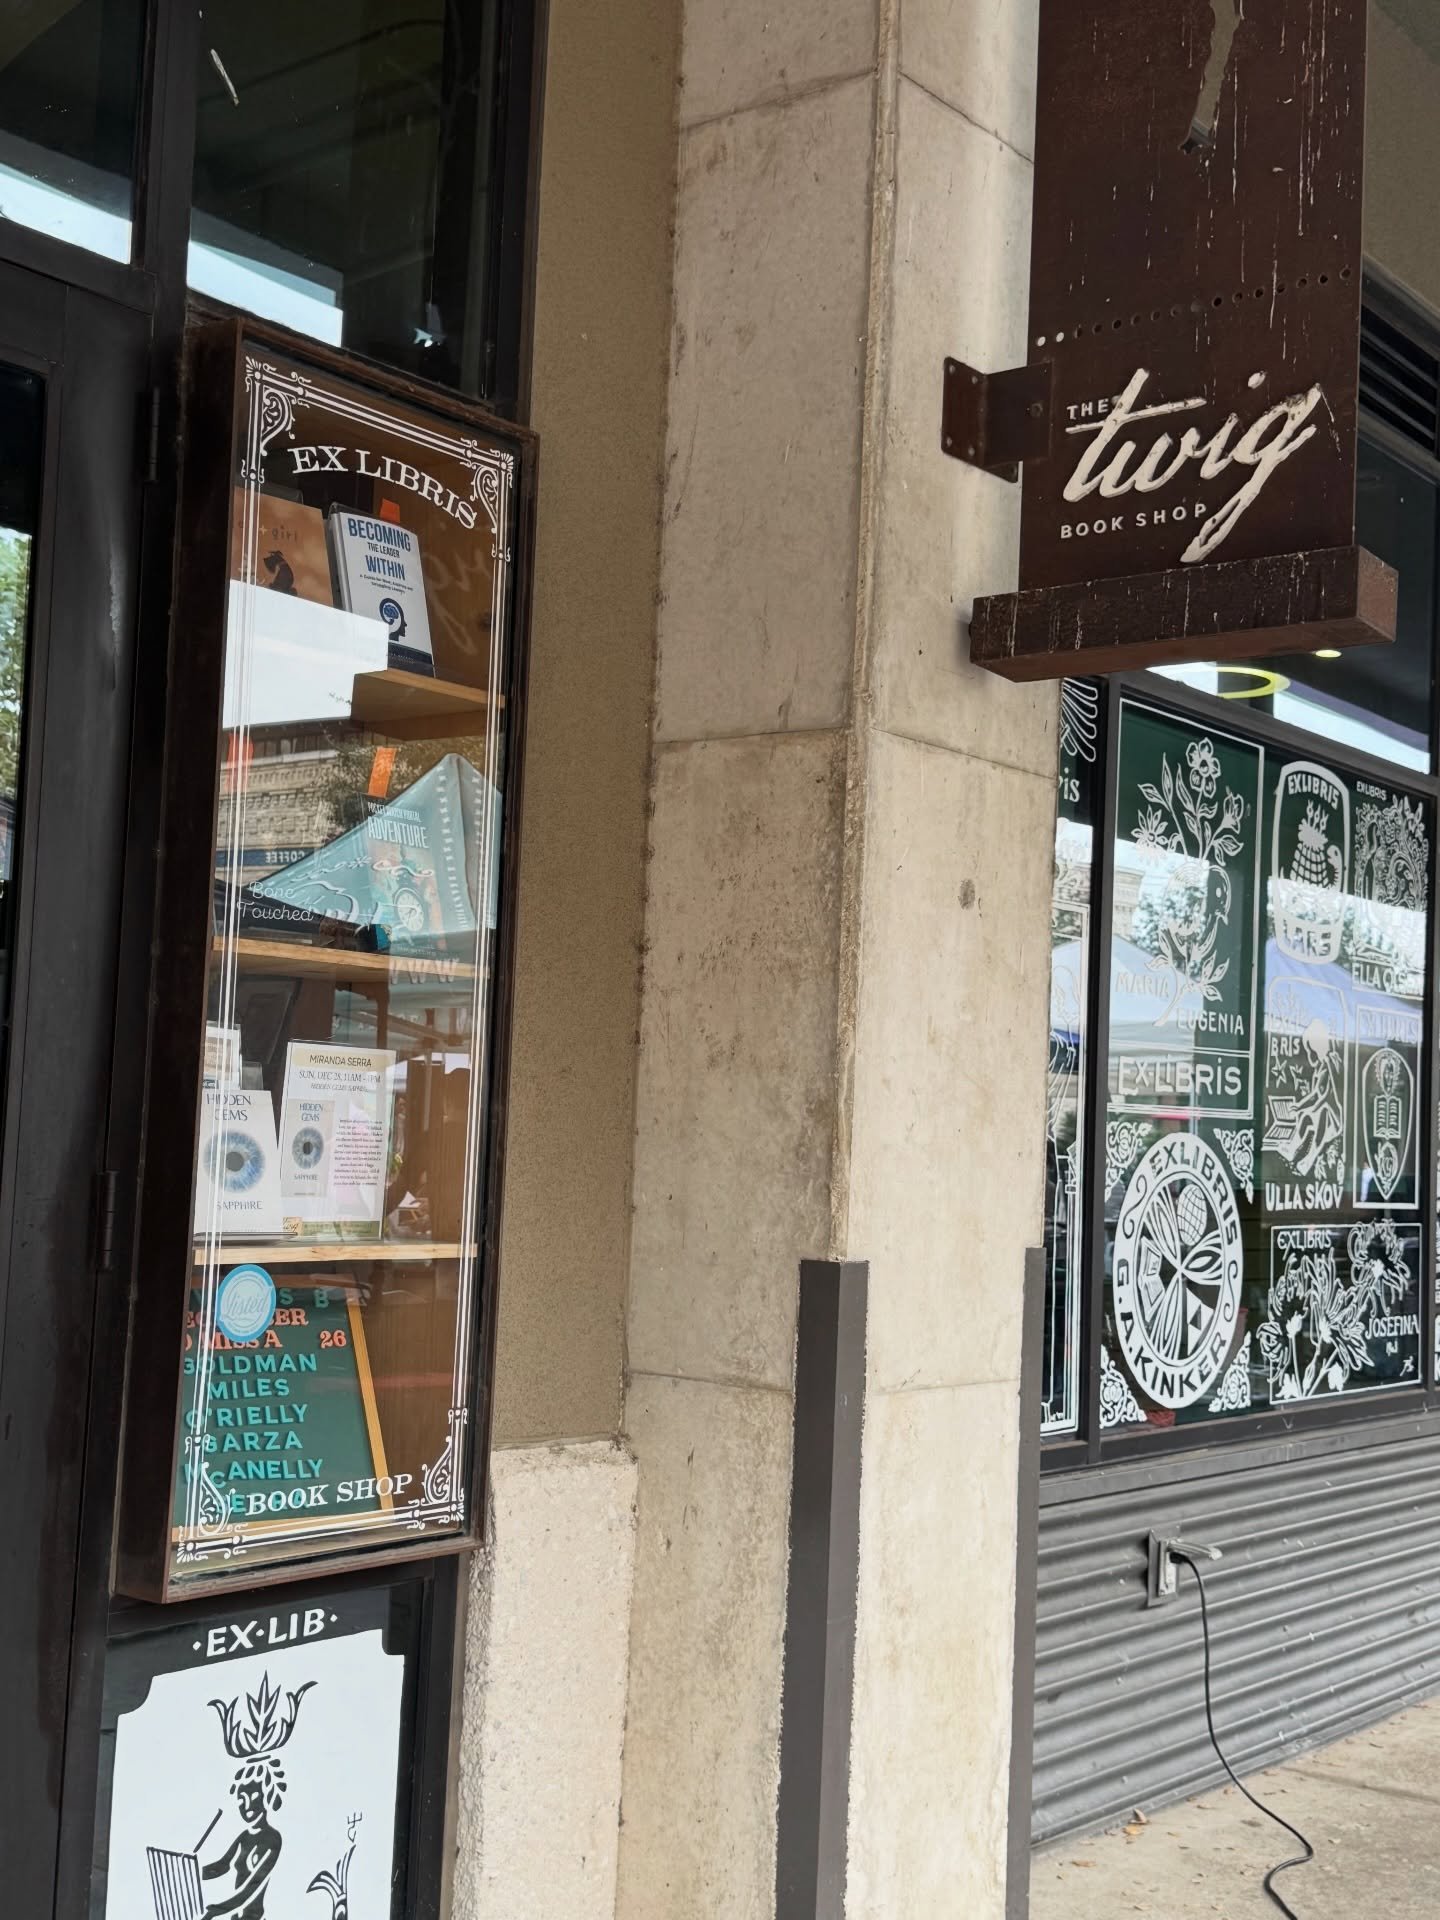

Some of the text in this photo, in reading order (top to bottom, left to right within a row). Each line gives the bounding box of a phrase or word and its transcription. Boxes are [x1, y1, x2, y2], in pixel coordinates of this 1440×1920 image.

[1066, 398, 1109, 421] THE
[1062, 367, 1322, 563] twig
[287, 445, 477, 530] EX LIBRIS
[1060, 503, 1208, 540] BOOK SHOP
[348, 517, 411, 552] BECOMING
[367, 542, 400, 558] THE LEADER
[365, 555, 406, 581] WITHIN
[368, 816, 429, 849] ADVENTURE
[250, 881, 294, 899] Bone
[237, 901, 314, 922] Touched
[1115, 972, 1169, 998] MARIA
[1177, 1008, 1244, 1036] EUGENIA
[310, 1055, 372, 1068] MIRANDA SERRA
[206, 1093, 252, 1106] HIDDEN
[214, 1109, 248, 1122] GEMS
[216, 1200, 264, 1210] SAPPHIRE
[1265, 1181, 1344, 1212] ULLA SKOV
[1364, 1314, 1420, 1340] JOSEFINA
[319, 1329, 347, 1350] 26
[206, 1378, 290, 1400] MILES
[203, 1430, 304, 1452] GARZA
[245, 1473, 413, 1516] BOOK SHOP
